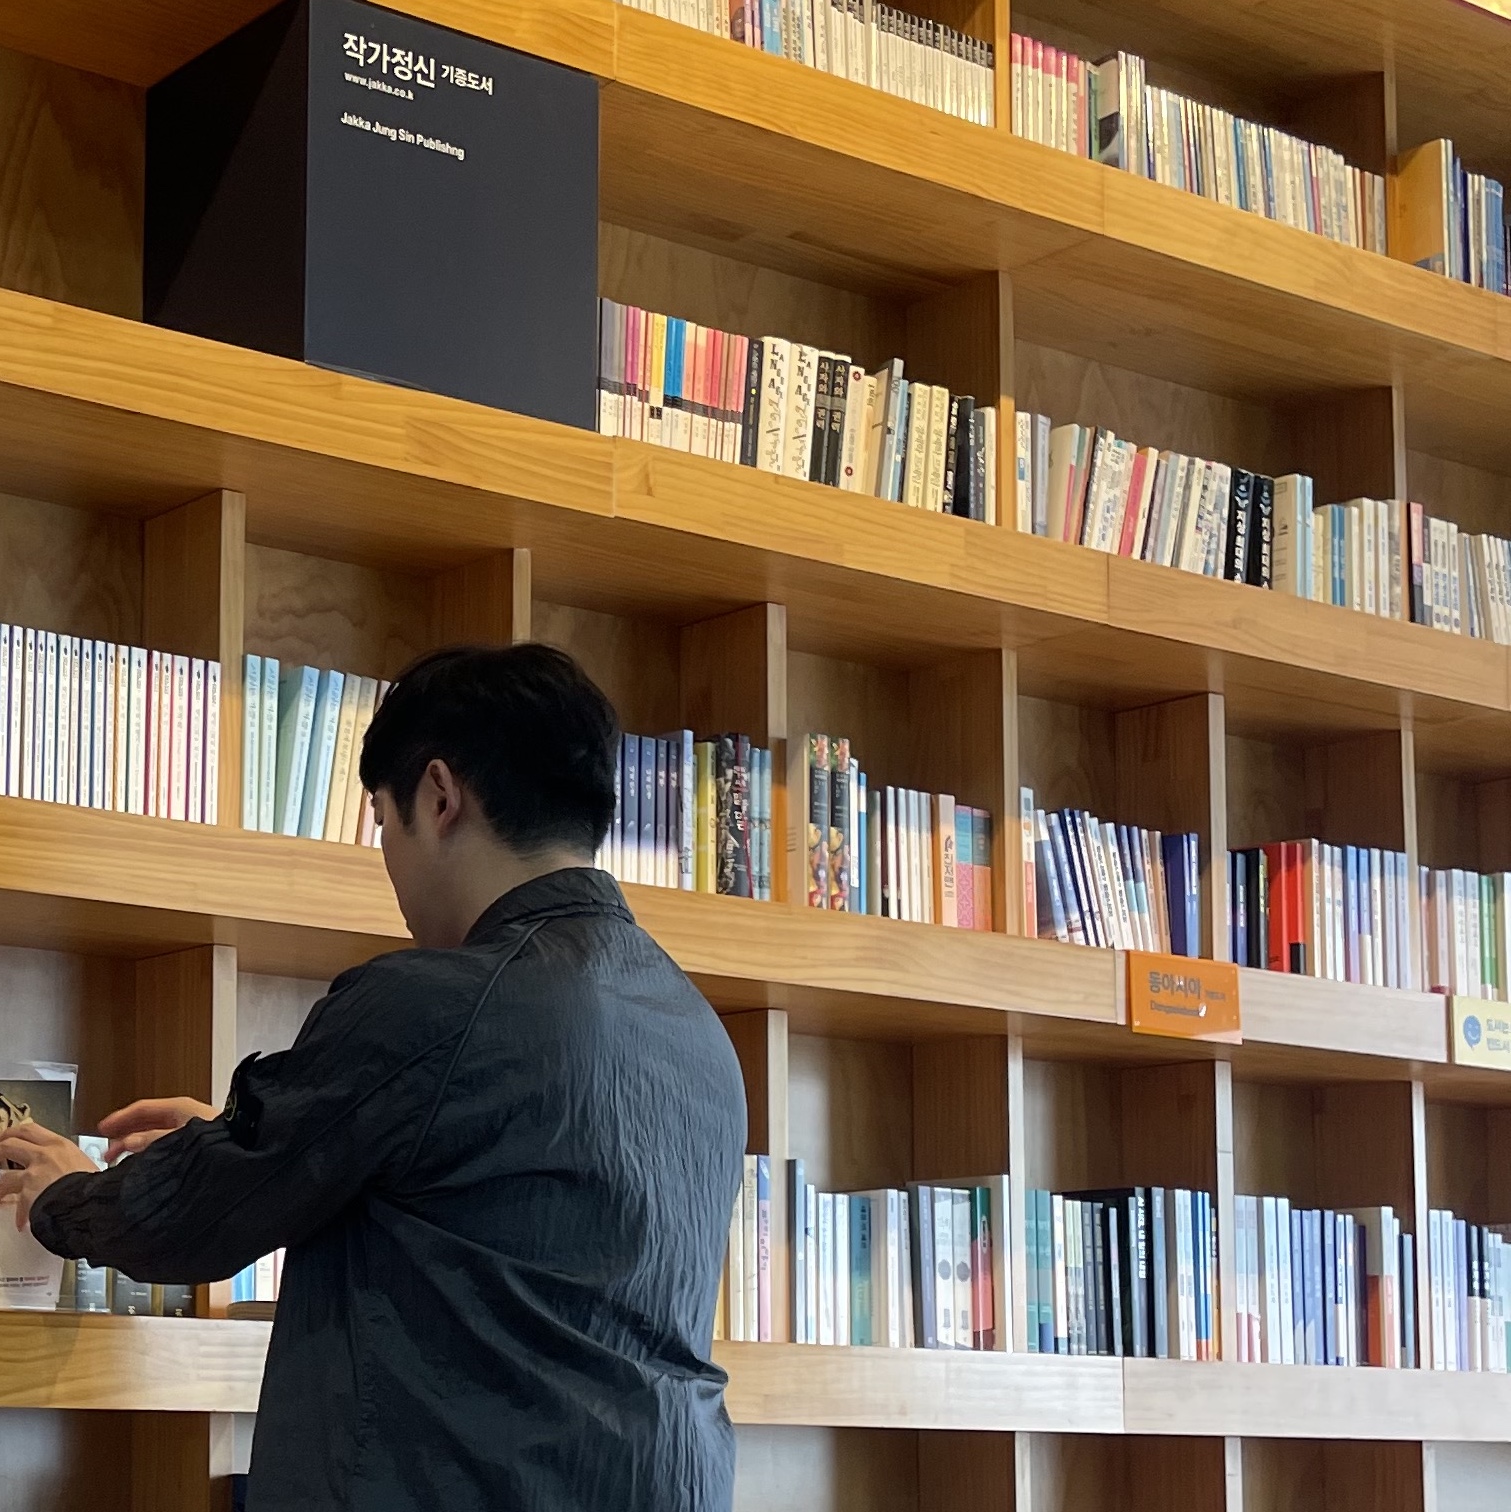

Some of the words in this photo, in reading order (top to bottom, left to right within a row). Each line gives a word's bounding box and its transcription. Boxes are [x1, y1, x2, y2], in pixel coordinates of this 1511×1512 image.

[343, 33, 435, 89] 작가정신
[441, 64, 493, 96] 기증도서
[341, 112, 371, 131] Jakka
[372, 121, 397, 141] Jung
[398, 128, 415, 144] Sin
[1149, 971, 1200, 999] 동아시아
